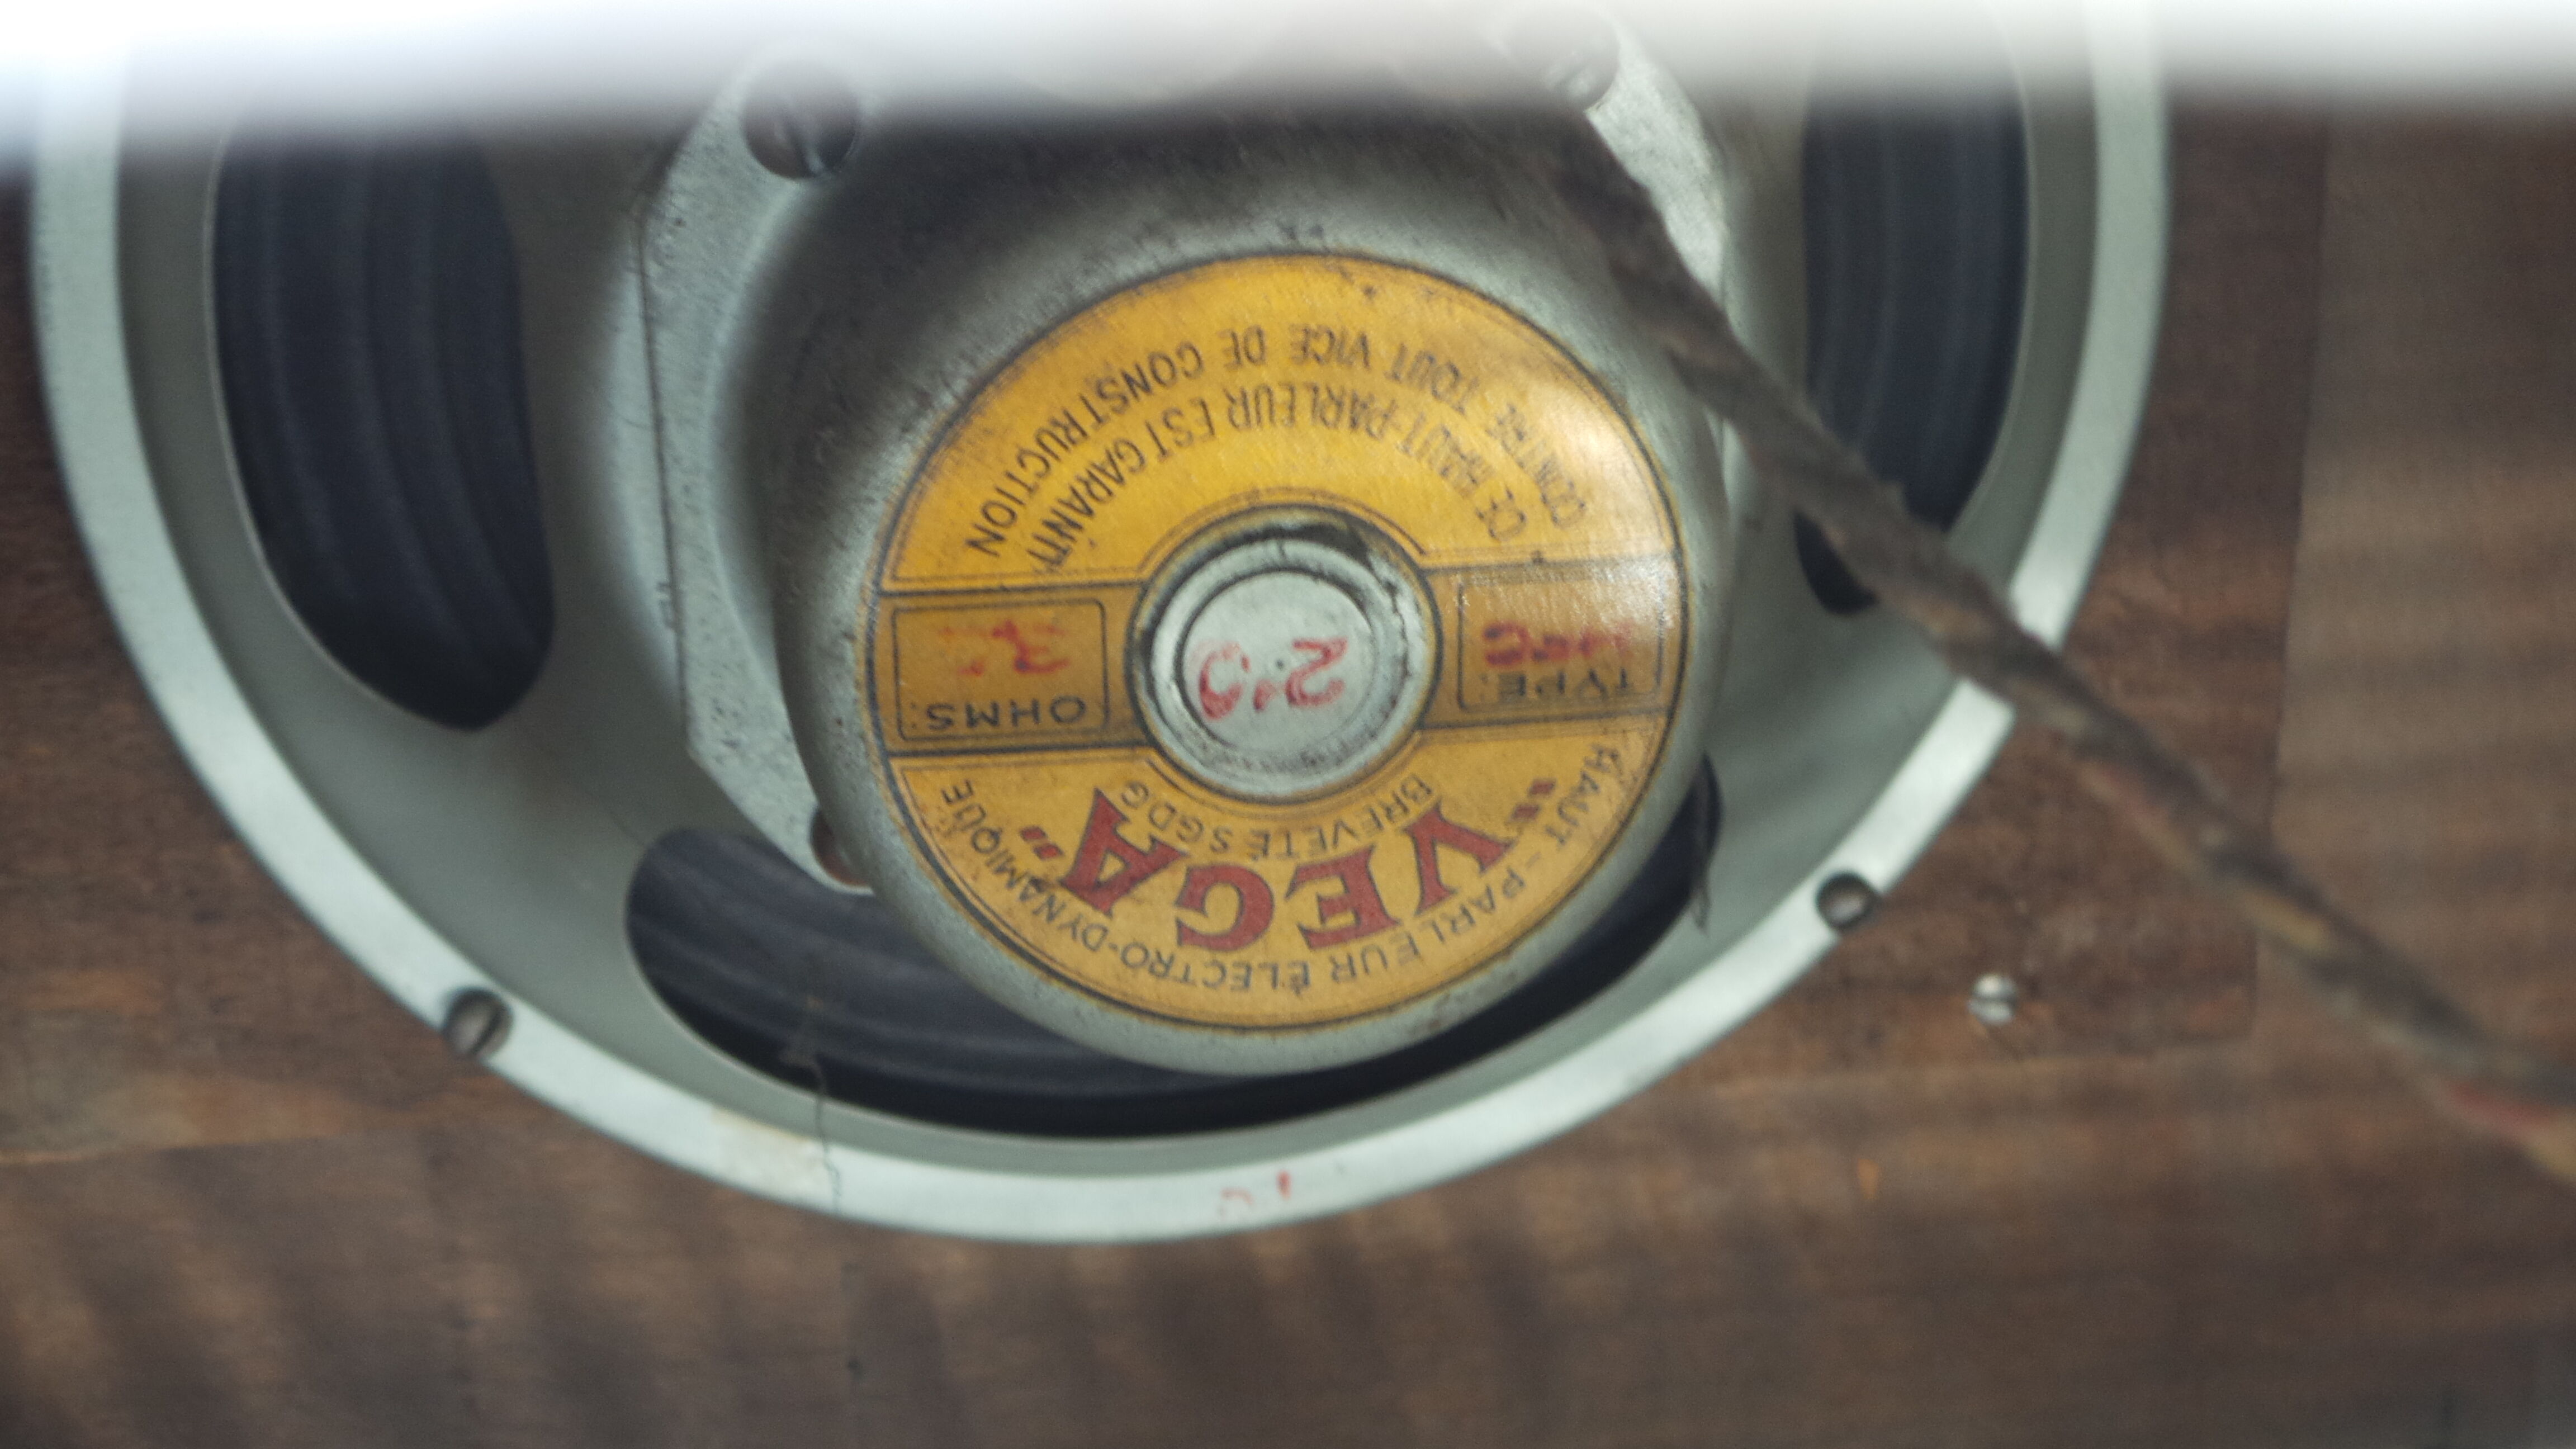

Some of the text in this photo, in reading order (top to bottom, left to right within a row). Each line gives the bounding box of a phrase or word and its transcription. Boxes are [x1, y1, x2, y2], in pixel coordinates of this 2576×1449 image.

[1218, 325, 1267, 369] DE
[1290, 324, 1371, 372] VICE
[965, 340, 1204, 557] CONSTRUCTION
[1144, 397, 1215, 462] EST
